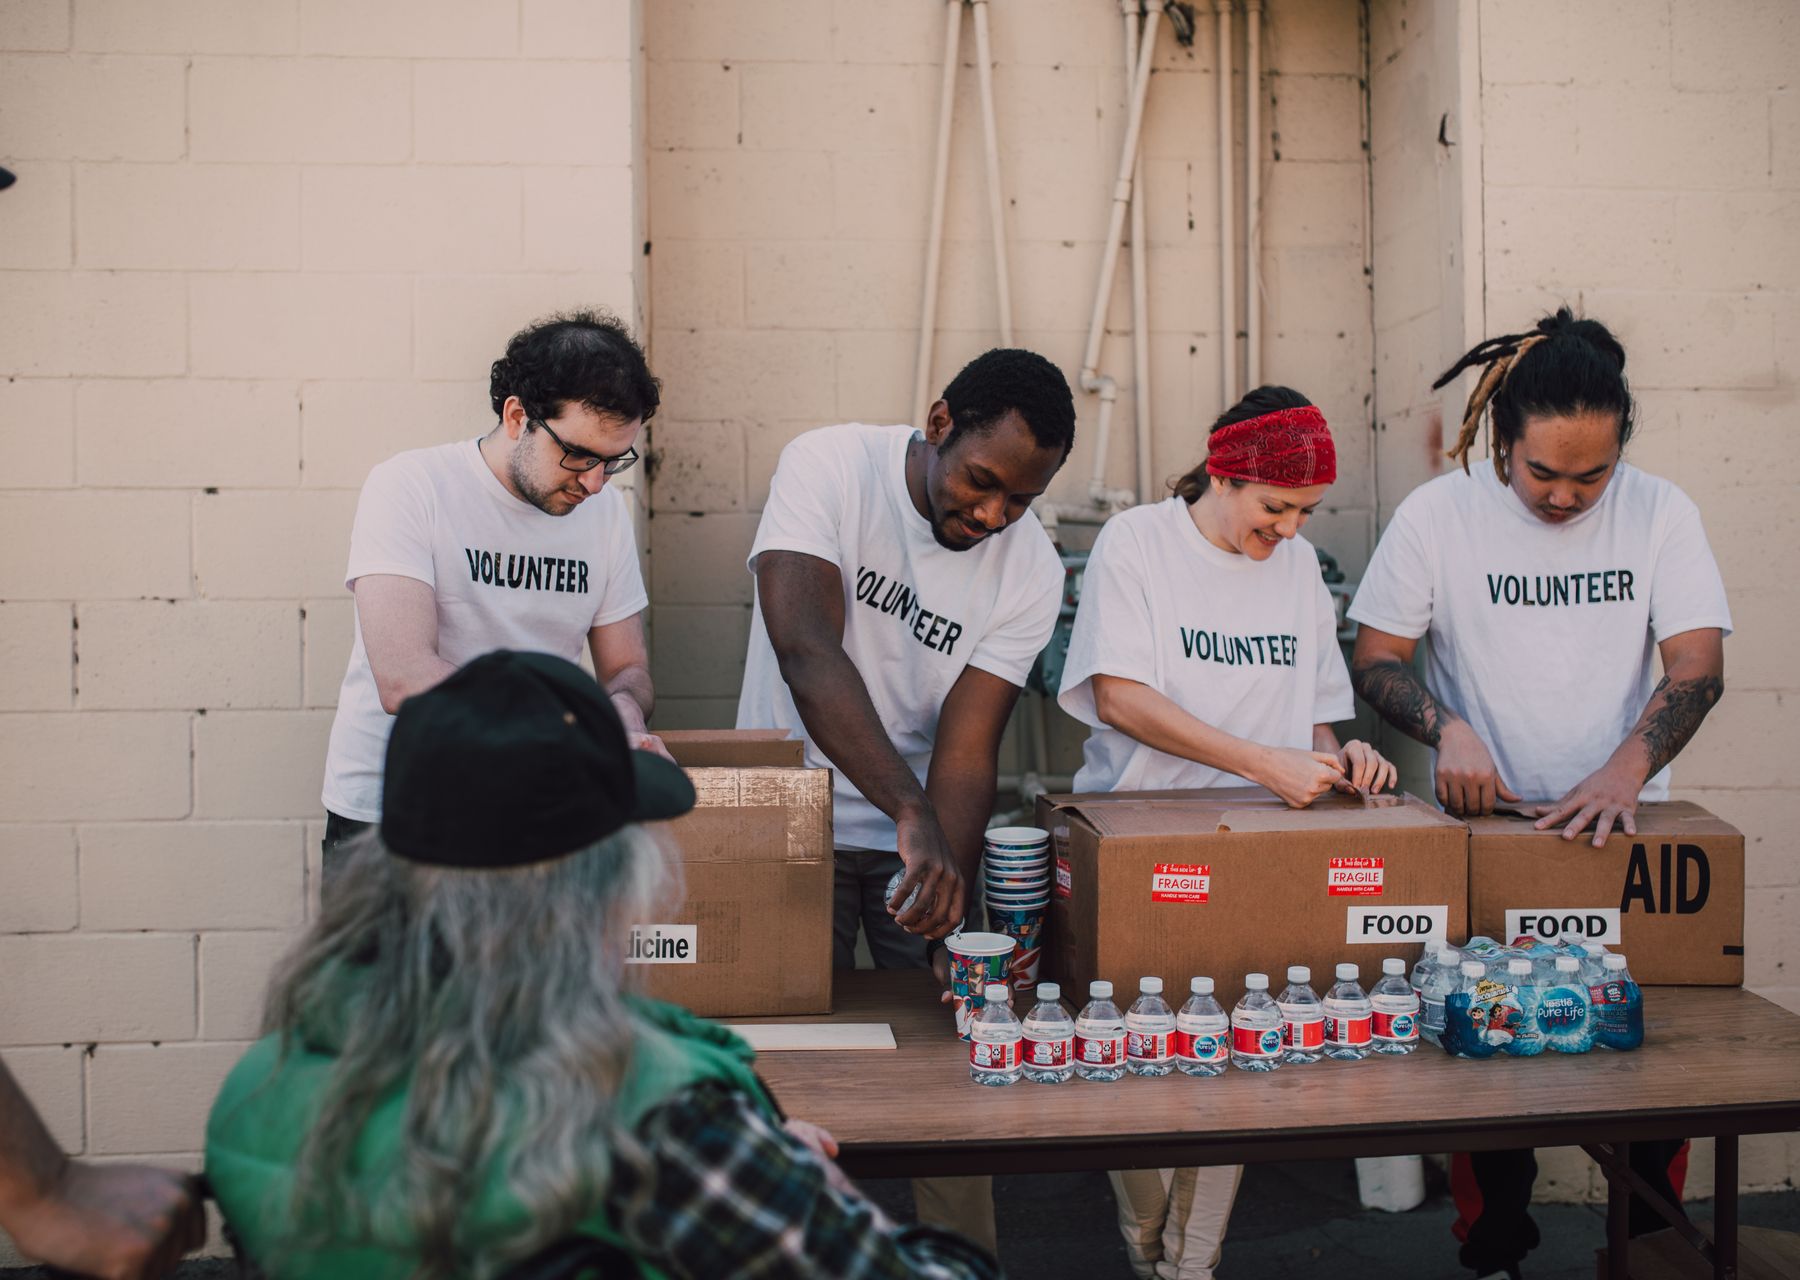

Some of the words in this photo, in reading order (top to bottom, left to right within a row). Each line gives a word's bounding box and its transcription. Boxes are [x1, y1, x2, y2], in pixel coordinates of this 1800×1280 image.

[465, 548, 589, 594] VOLUNTEER
[1486, 569, 1635, 607] VOLUNTEER
[1158, 878, 1206, 890] FRAGILE
[1333, 872, 1380, 883] FRAGILE
[1620, 843, 1711, 914] AID
[1362, 914, 1433, 935] FOOD
[1519, 914, 1608, 938] FOOD
[624, 930, 689, 959] dicine
[1537, 1007, 1562, 1019] Pure
[1564, 1005, 1585, 1021] Life
